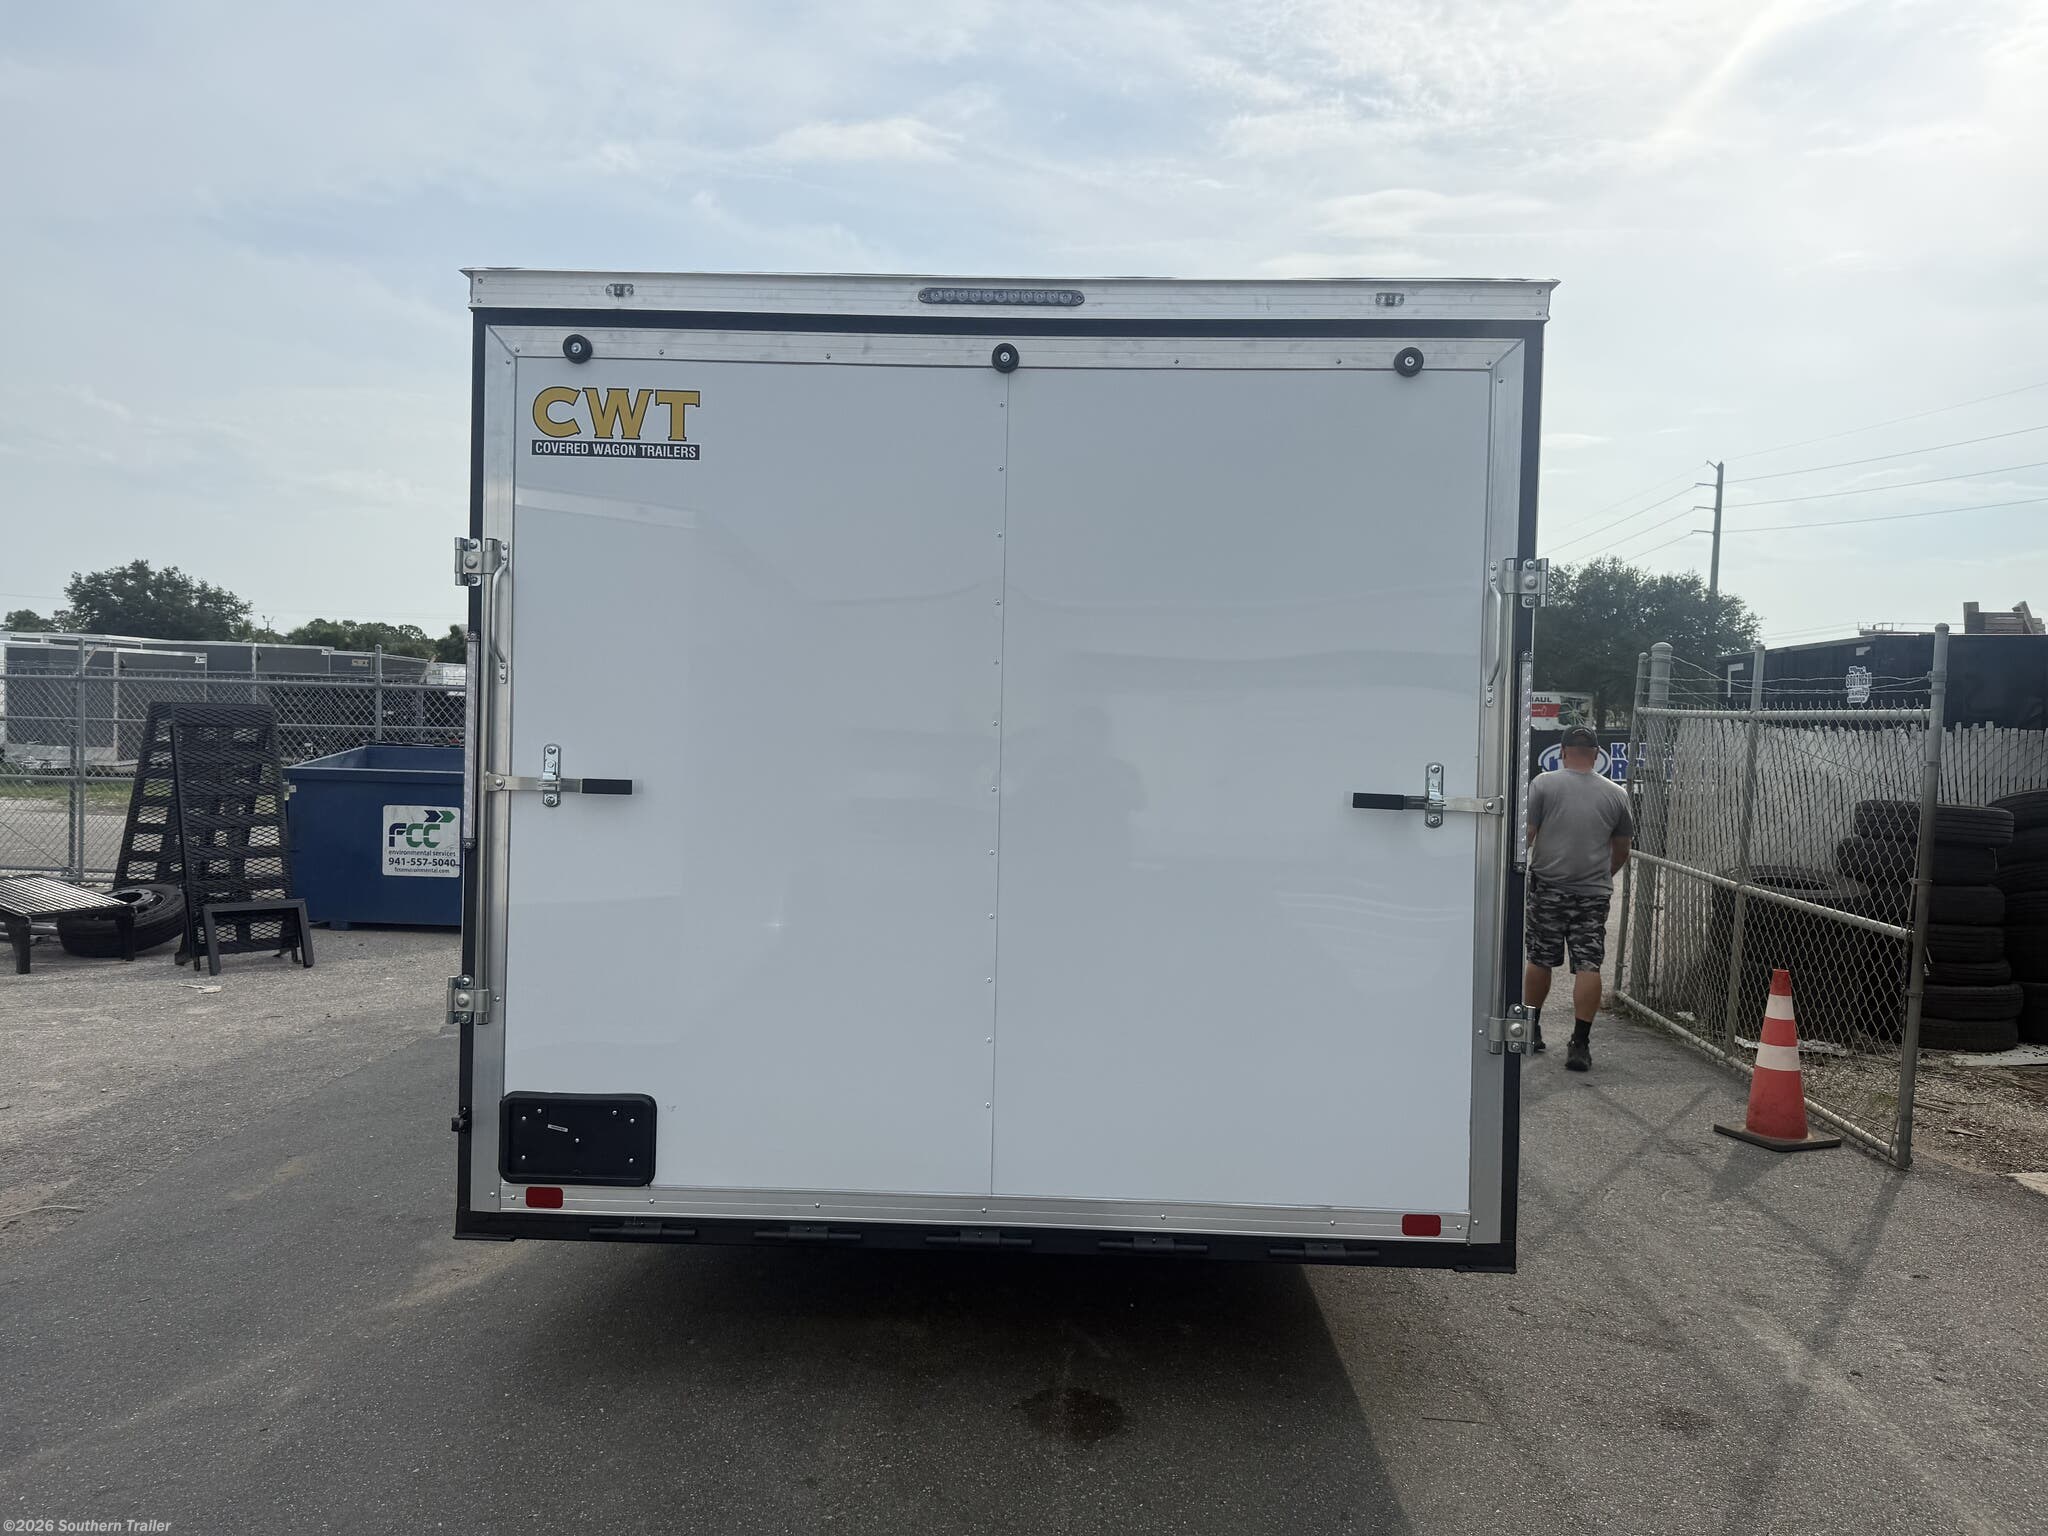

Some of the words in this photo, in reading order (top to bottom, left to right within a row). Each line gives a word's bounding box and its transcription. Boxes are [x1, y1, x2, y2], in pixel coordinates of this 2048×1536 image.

[532, 386, 701, 441] CWT
[535, 441, 589, 455] COVERED
[593, 443, 637, 456] WAGON
[640, 444, 697, 458] TRAILERS
[388, 823, 440, 848] FCC
[388, 857, 456, 867] 941-557-5040
